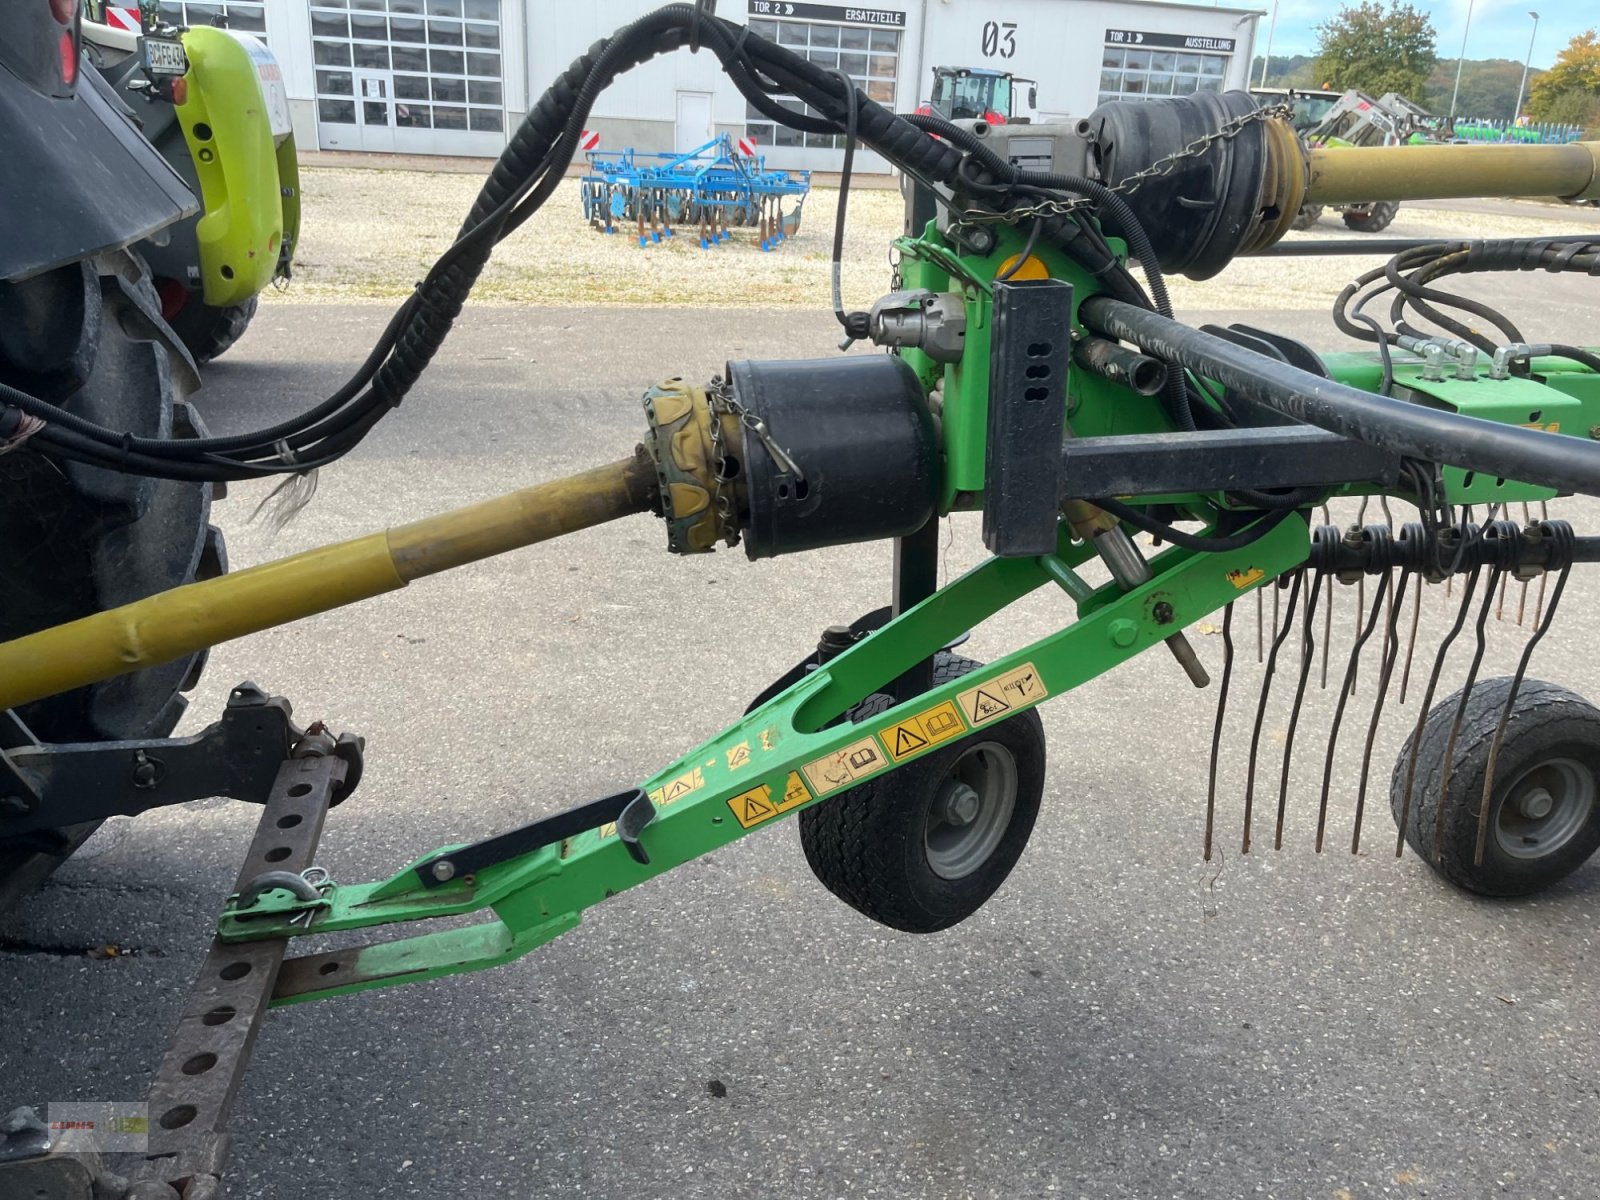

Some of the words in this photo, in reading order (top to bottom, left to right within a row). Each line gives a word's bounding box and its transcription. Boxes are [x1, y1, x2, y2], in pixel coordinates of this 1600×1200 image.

[753, 1, 770, 13] TOR
[774, 4, 781, 14] 2
[845, 9, 901, 24] ERSATZTEILE
[981, 20, 1018, 58] 03
[1110, 31, 1124, 42] TOR
[1127, 32, 1132, 42] 1
[1184, 37, 1231, 50] AUSSTELLUNG
